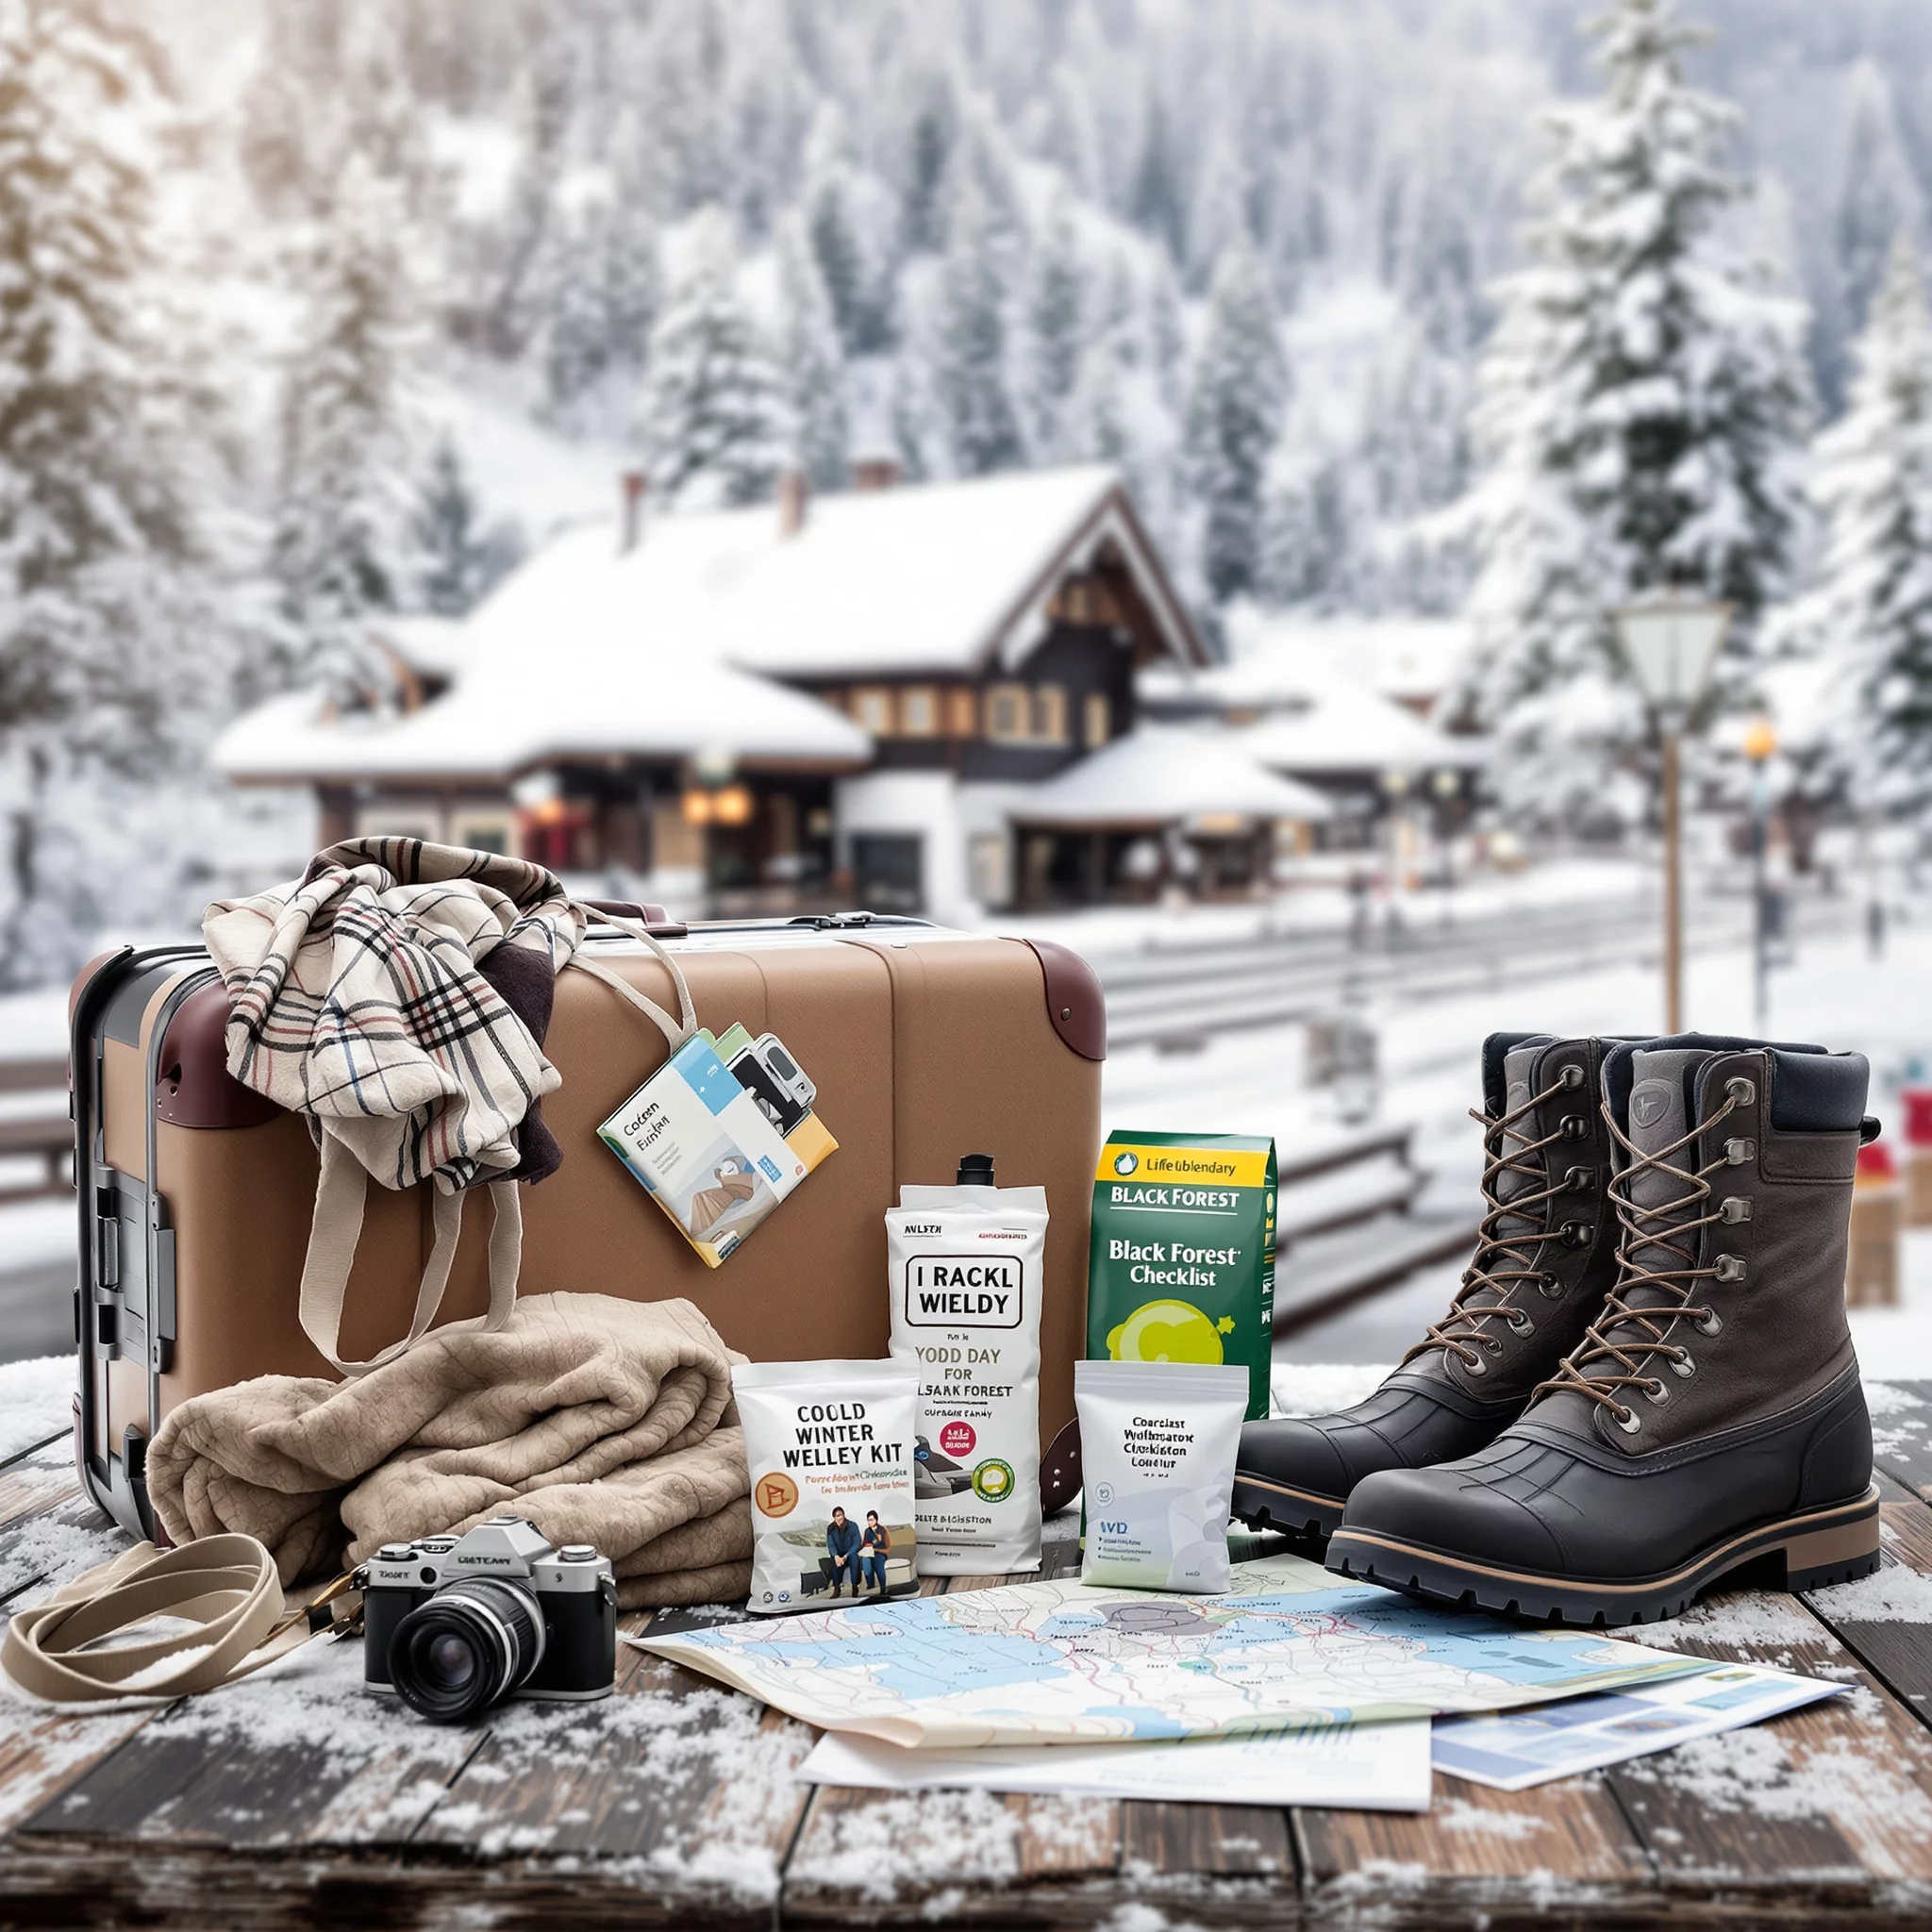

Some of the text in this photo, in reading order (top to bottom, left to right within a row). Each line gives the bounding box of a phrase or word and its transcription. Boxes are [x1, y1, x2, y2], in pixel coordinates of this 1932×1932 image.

[1110, 1186, 1240, 1208] BLACK FOREST
[1109, 1240, 1237, 1266] Black Forest
[933, 1266, 1013, 1288] RACKL
[1130, 1265, 1217, 1287] Checklist
[919, 1293, 1009, 1314] WIELDY
[915, 1346, 1001, 1364] YODD DAY
[944, 1368, 973, 1380] FOR
[964, 1385, 1014, 1397] FOREST
[797, 1403, 866, 1423] COOLD
[795, 1424, 874, 1445] WINTER
[782, 1443, 903, 1468] WELLEY KIT
